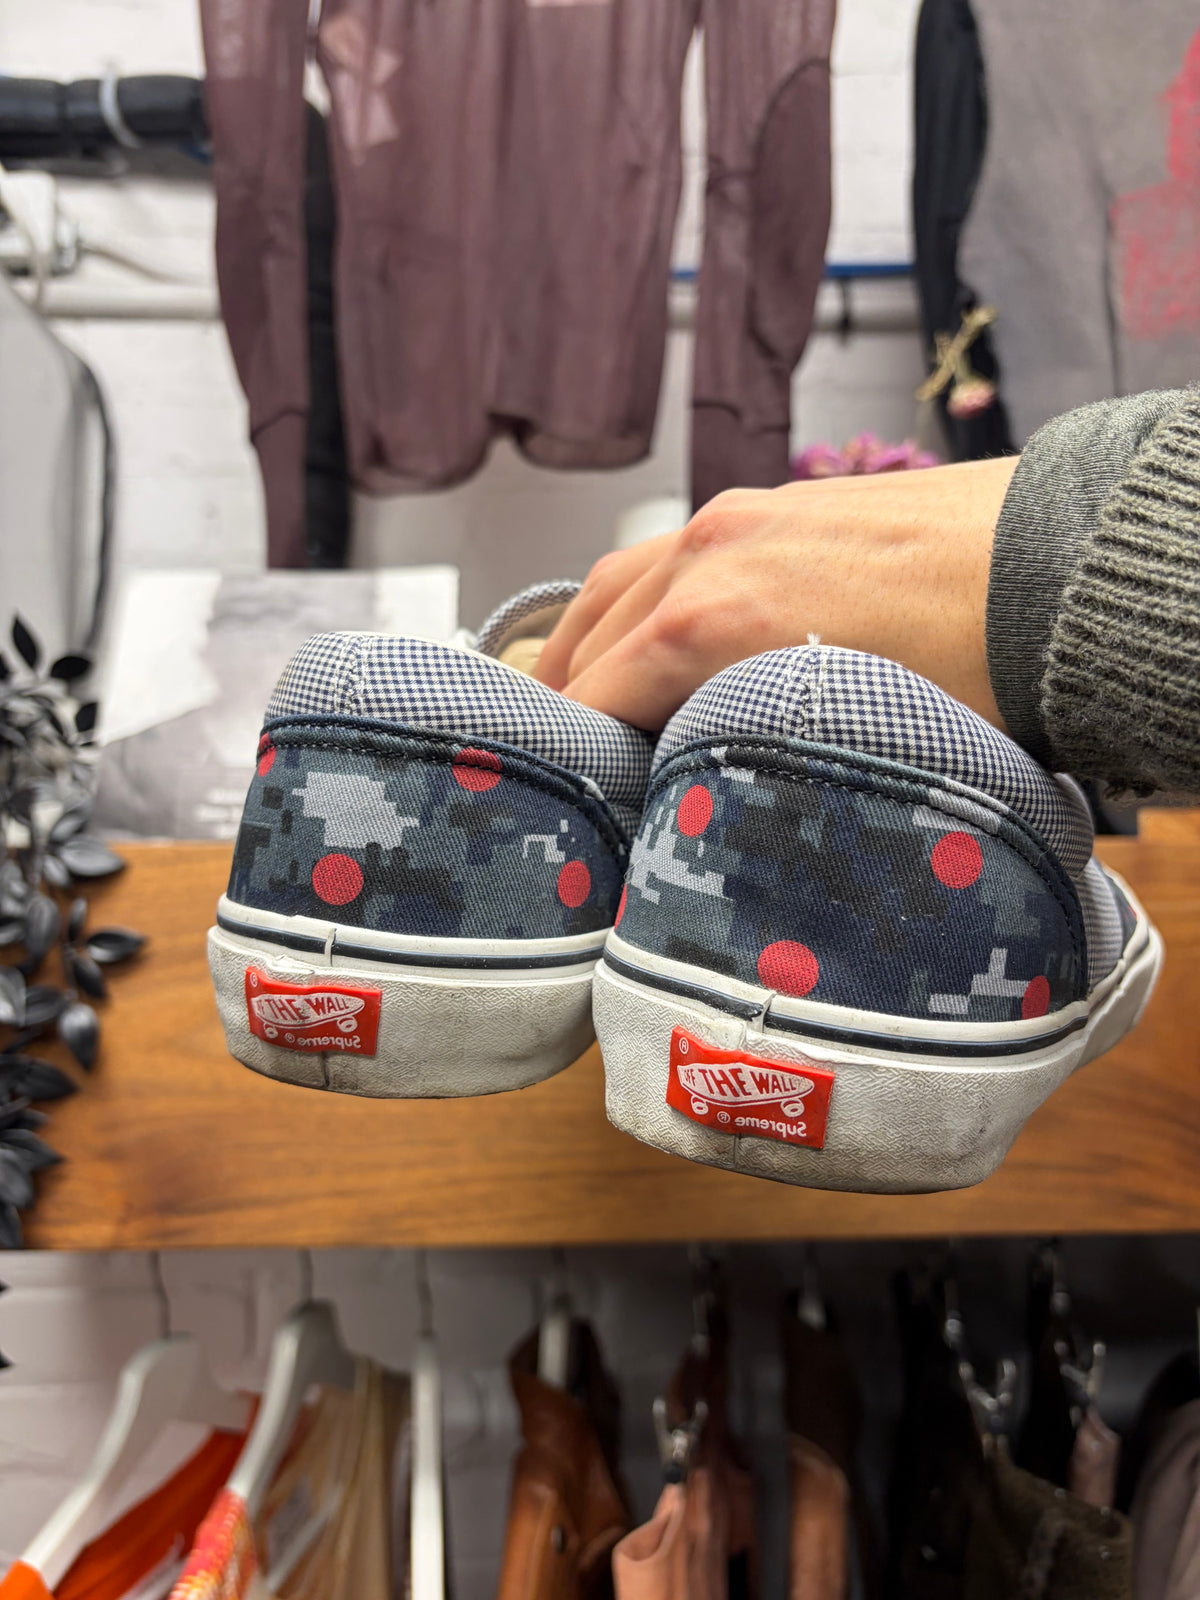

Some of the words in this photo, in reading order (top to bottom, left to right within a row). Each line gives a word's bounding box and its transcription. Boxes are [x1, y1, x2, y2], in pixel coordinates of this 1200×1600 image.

[265, 998, 310, 1021] THE
[305, 996, 350, 1017] WALL
[698, 1067, 753, 1098] THE
[750, 1070, 797, 1095] WALL
